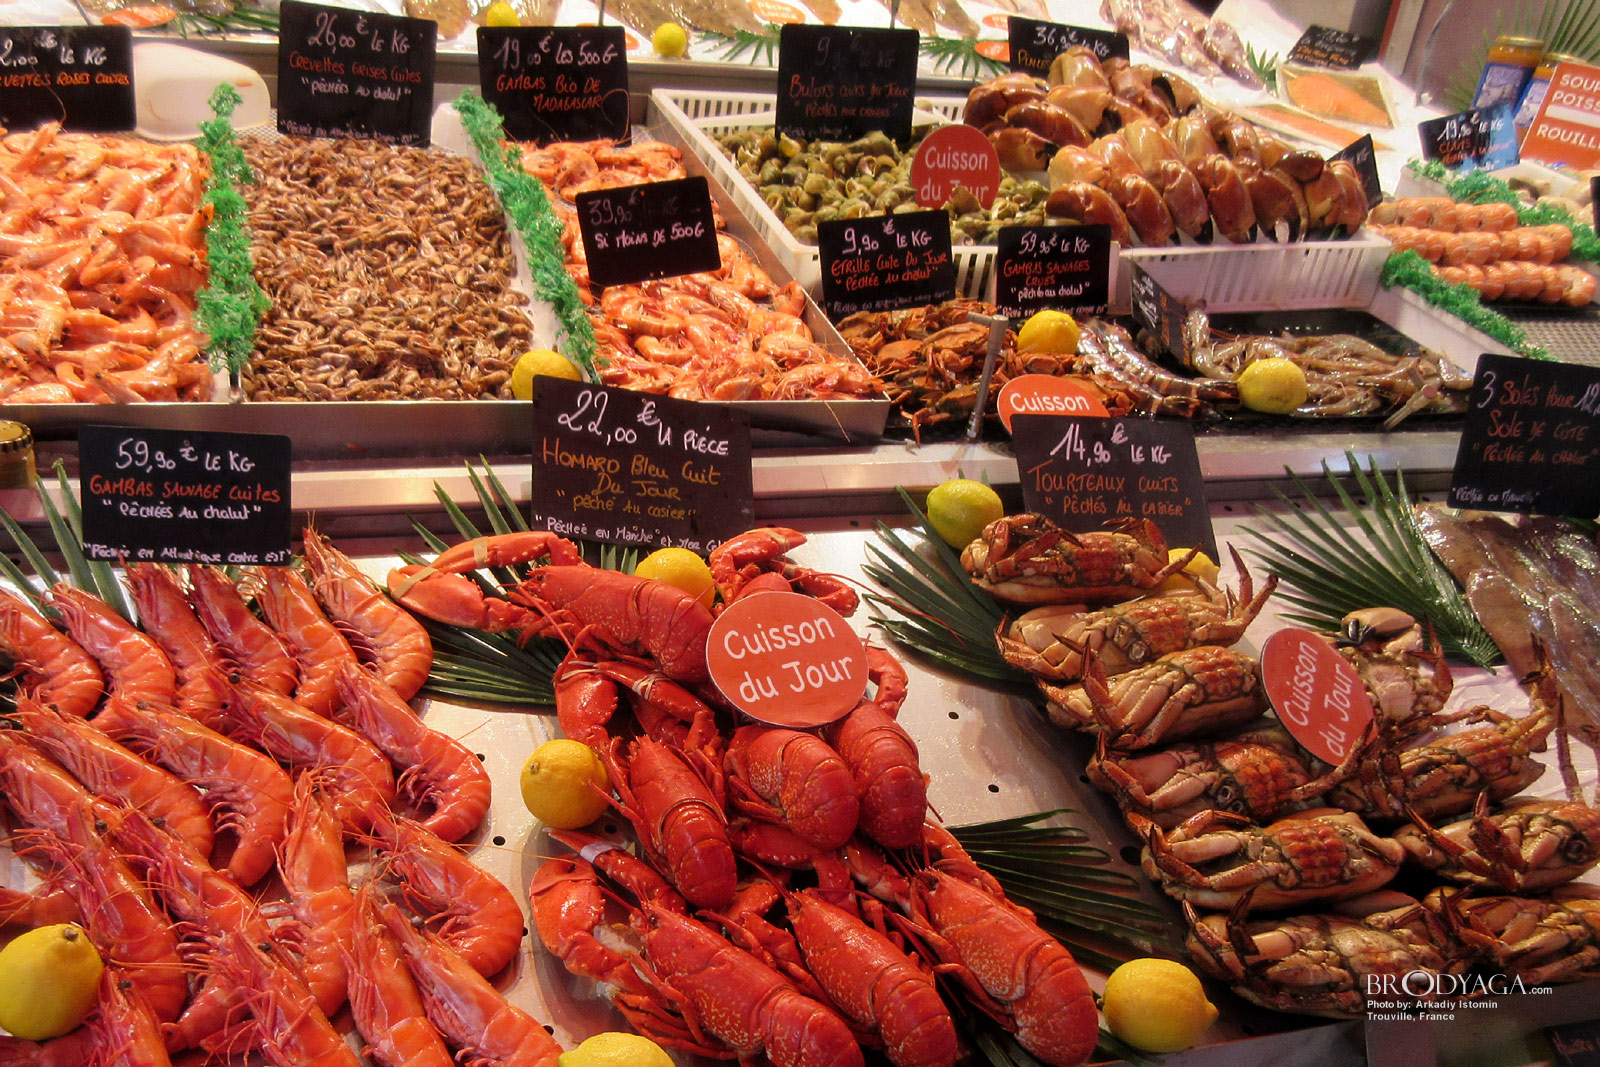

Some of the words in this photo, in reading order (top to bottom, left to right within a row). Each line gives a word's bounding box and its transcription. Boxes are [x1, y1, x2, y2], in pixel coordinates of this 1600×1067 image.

[307, 12, 356, 54] 26,00
[391, 30, 410, 54] KG
[0, 73, 52, 88] VETTES
[496, 74, 547, 93] GAMBAS
[533, 93, 604, 112] MADAGASCAR
[925, 146, 989, 171] Cuisson
[920, 177, 942, 201] du
[842, 227, 880, 256] 9,90
[911, 229, 932, 247] KG
[1003, 259, 1043, 277] GAMBAS
[1025, 275, 1057, 288] CRUES
[1009, 391, 1090, 413] Cuisson
[1477, 371, 1497, 408] 3
[558, 390, 637, 446] 22,00
[637, 401, 661, 427] €
[115, 437, 177, 474] 59,90
[229, 451, 256, 473] KG
[1050, 422, 1111, 468] 14,90
[1111, 422, 1130, 446] €
[1151, 446, 1173, 465] KG
[90, 475, 156, 498] GAMBAS
[162, 481, 223, 500] SAUVAGE
[1027, 458, 1125, 492] TOURTEAUX
[724, 617, 837, 660] Cuisson
[739, 671, 779, 703] du
[781, 656, 853, 693] Jour
[1284, 641, 1319, 727] Cuisson
[1323, 663, 1353, 722] Jour
[1318, 723, 1347, 757] du
